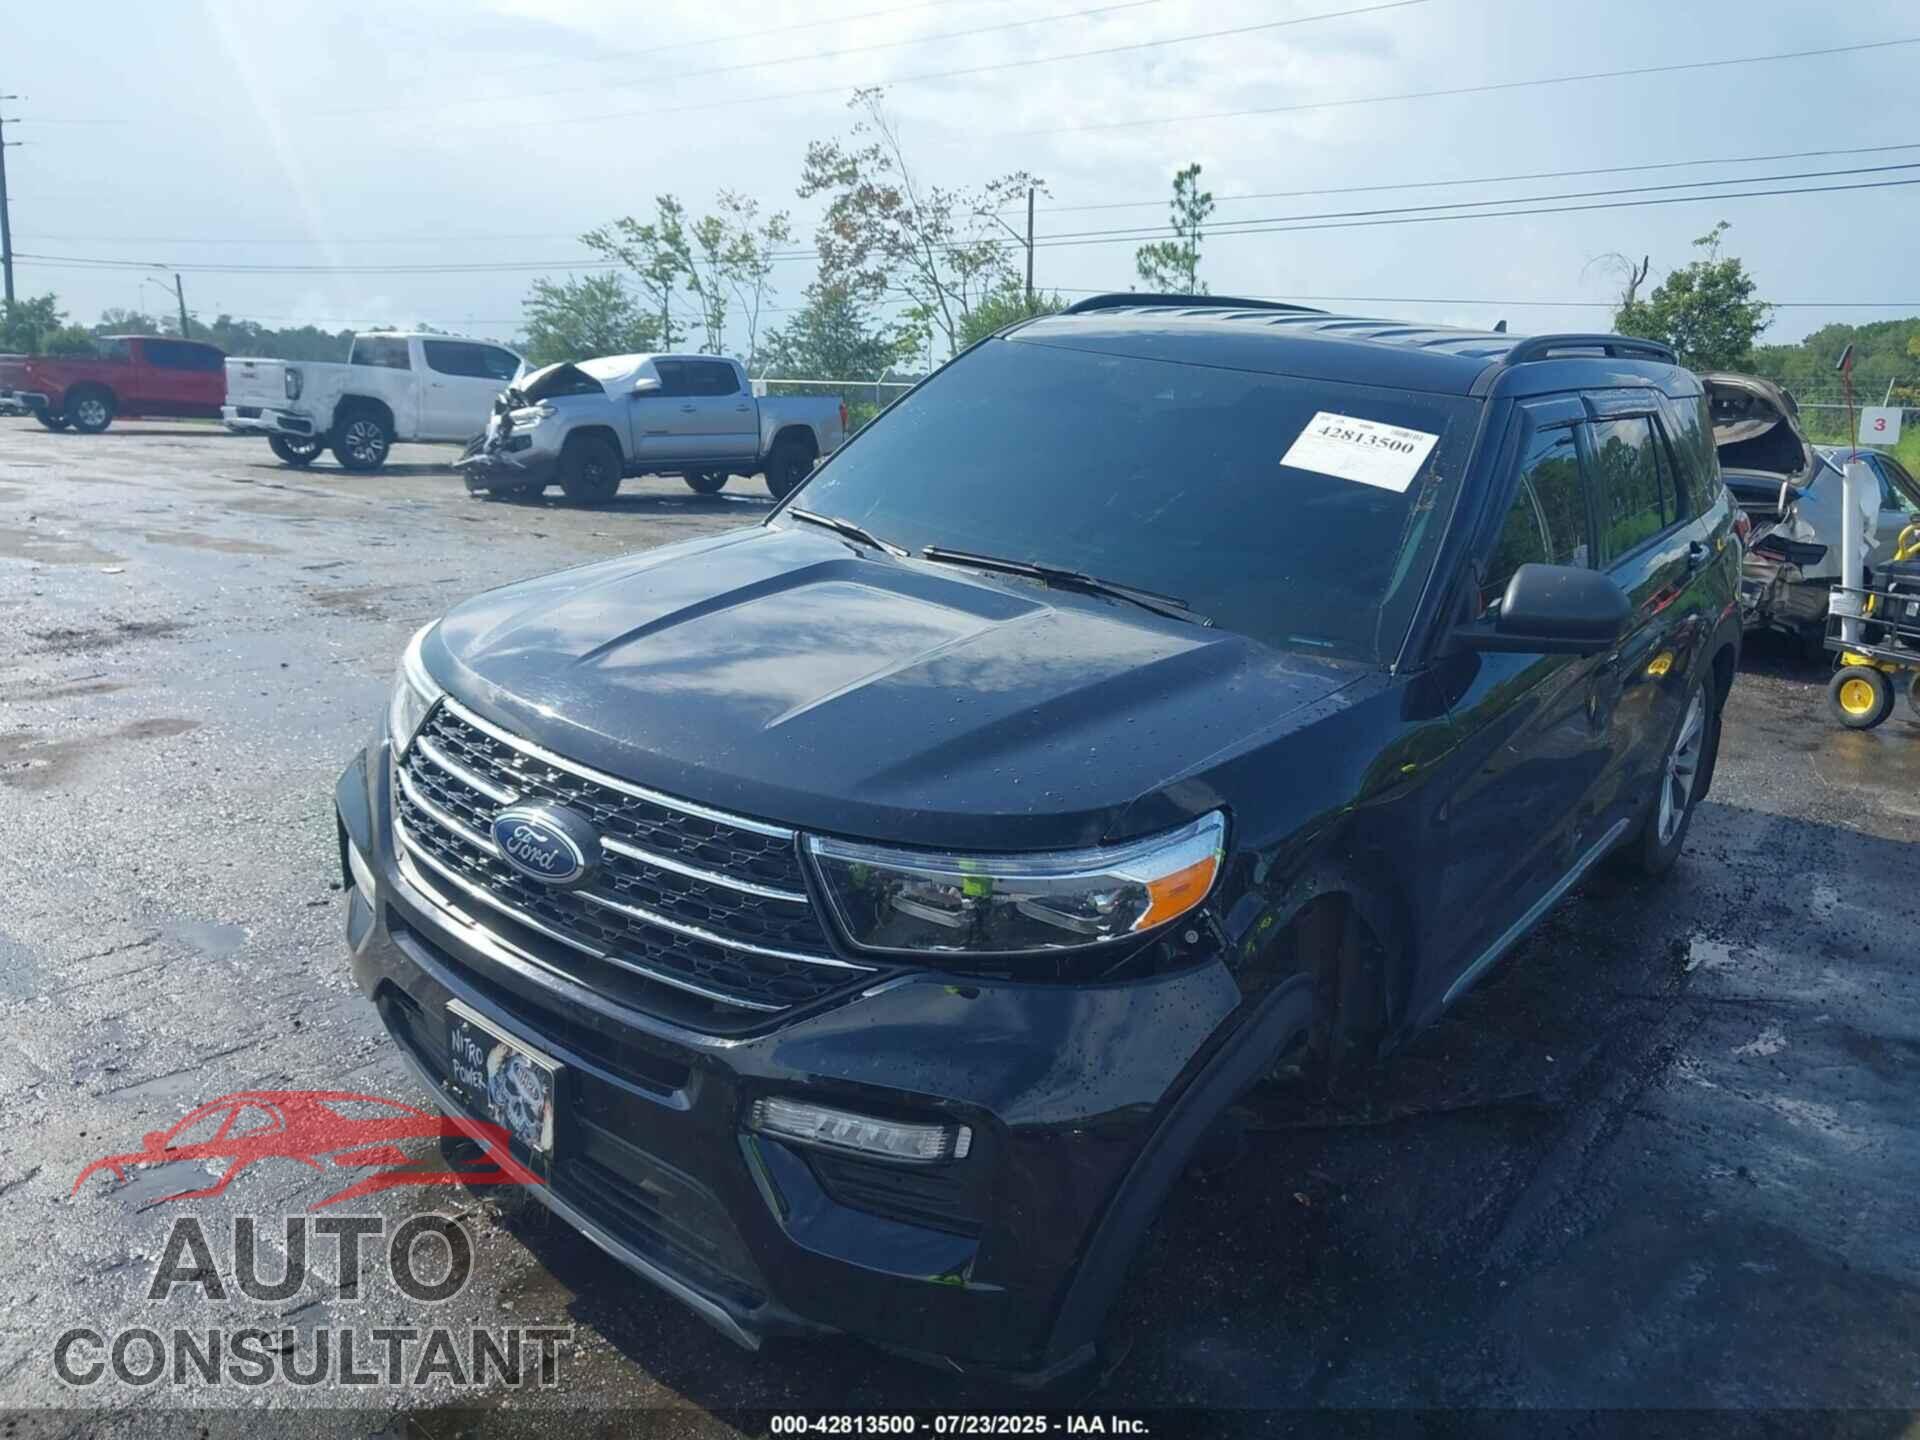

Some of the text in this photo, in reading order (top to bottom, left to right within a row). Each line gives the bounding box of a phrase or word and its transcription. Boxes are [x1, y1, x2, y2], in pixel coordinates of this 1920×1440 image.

[1317, 424, 1416, 455] 42813500
[1873, 417, 1887, 432] 3
[506, 825, 559, 871] Ford
[451, 1028, 485, 1067] NITRO
[452, 1058, 487, 1090] POWER
